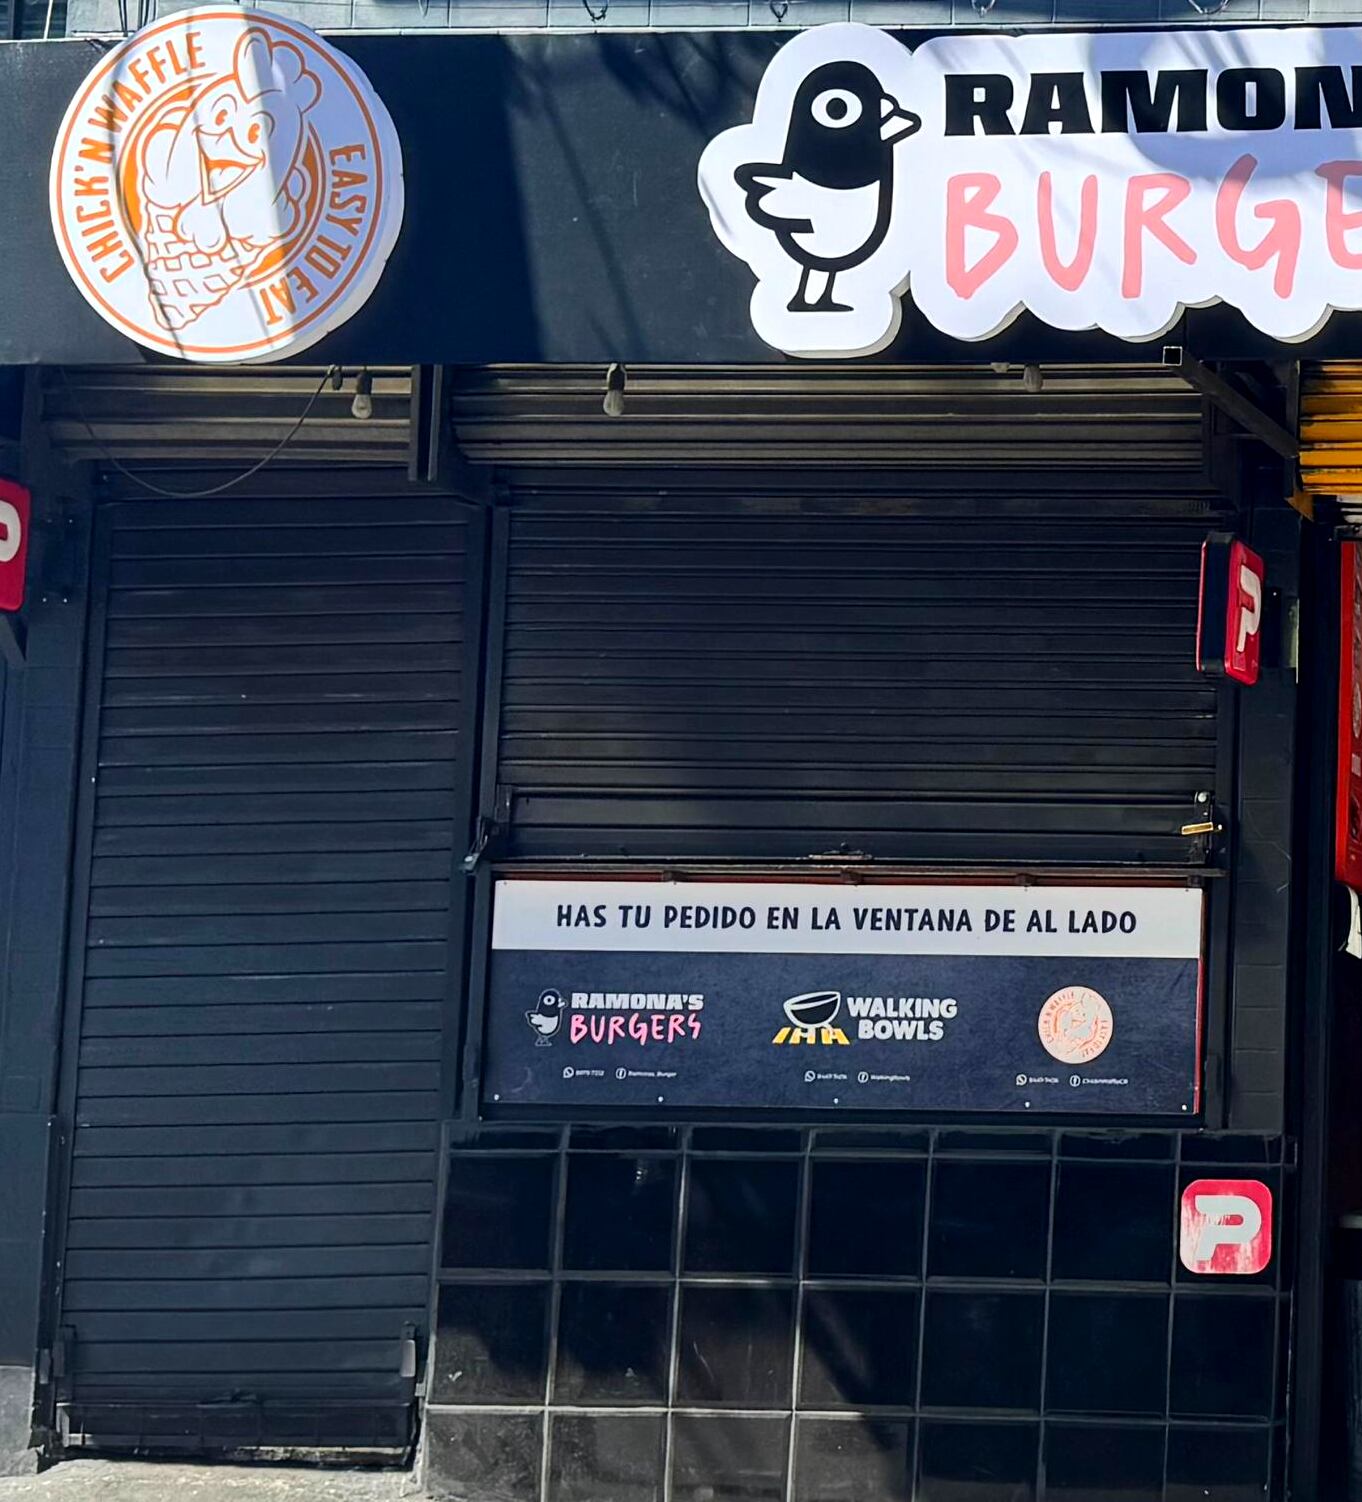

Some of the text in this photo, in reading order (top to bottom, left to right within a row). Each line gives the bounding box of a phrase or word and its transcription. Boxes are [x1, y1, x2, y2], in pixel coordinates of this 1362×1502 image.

[74, 31, 207, 284] CHICK'N WAFFLE
[263, 143, 367, 325] EASY TO EAT
[557, 905, 1138, 934] HAS TU PEDIDO EN LA VENTANA DE AL LADO
[571, 993, 704, 1010] RAMONA'S
[847, 997, 958, 1019] WALKING
[569, 1012, 702, 1046] BURGERS
[858, 1019, 944, 1041] BOWLS
[1195, 1195, 1262, 1261] P
